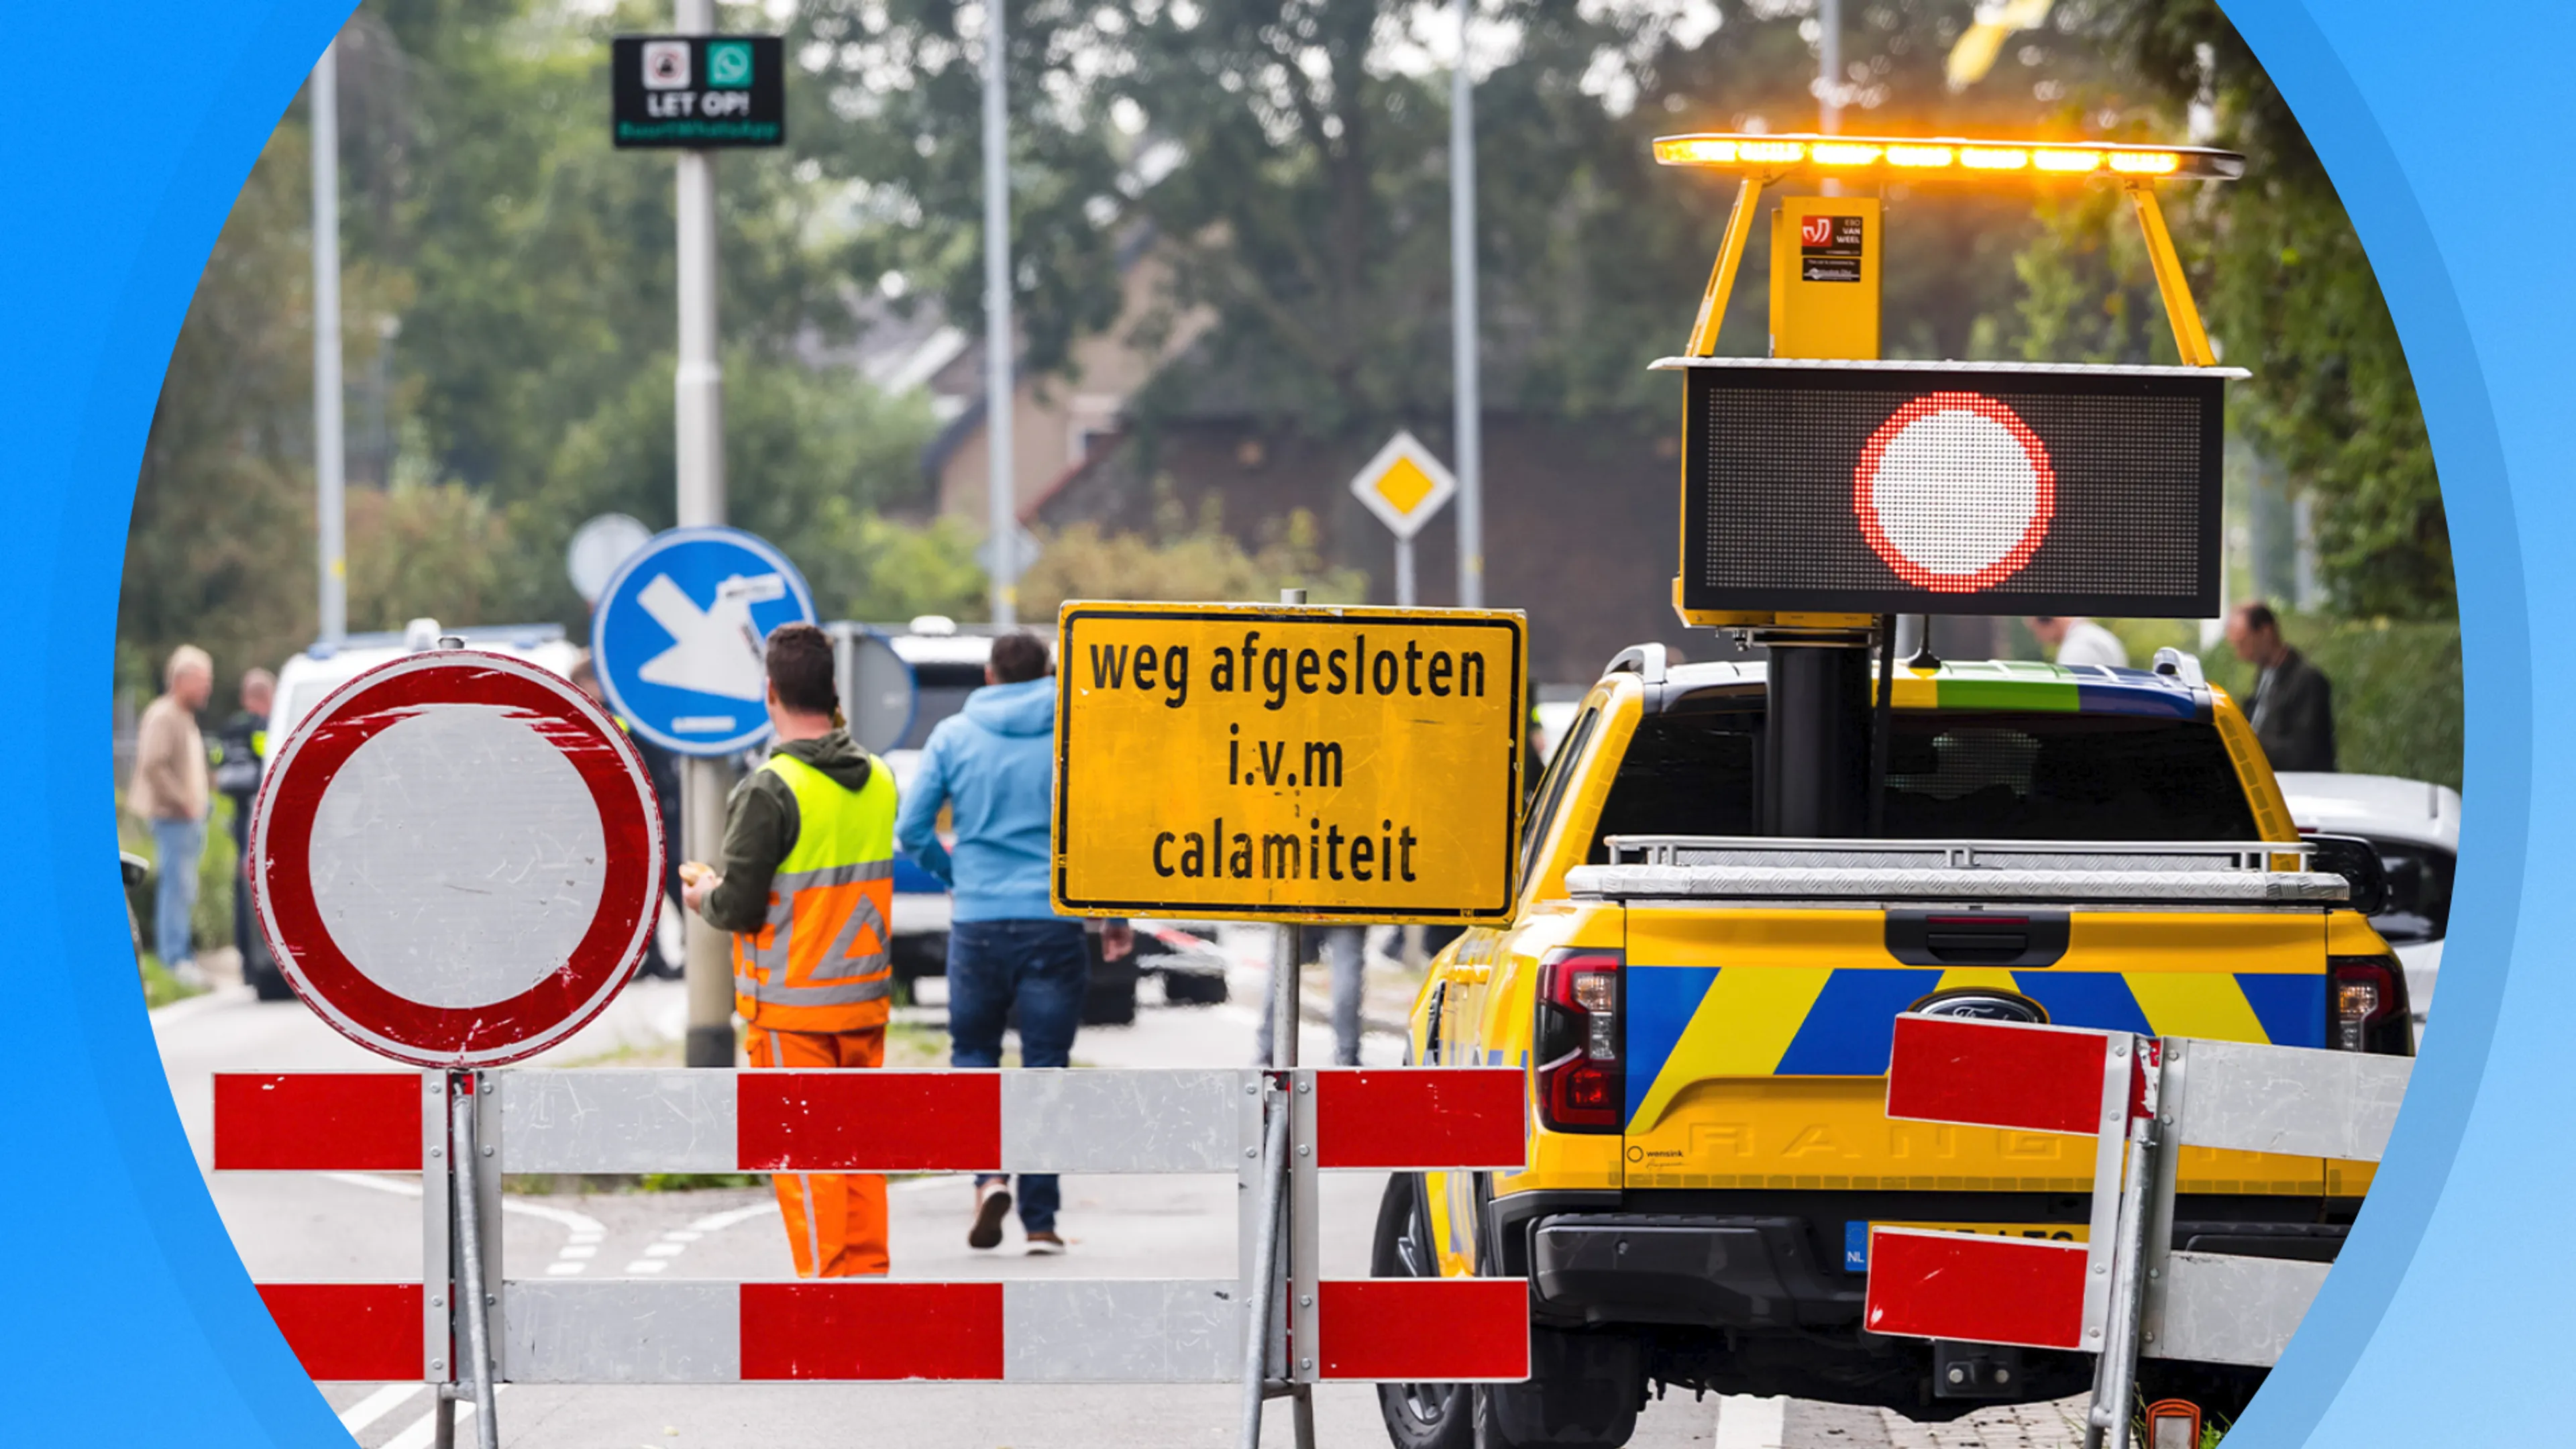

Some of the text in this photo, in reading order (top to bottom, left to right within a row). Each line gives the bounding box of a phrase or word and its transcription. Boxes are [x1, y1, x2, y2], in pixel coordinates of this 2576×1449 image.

[647, 91, 750, 117] LET OP!
[1836, 235, 1860, 244] WEEL
[1089, 631, 1485, 710] weg afgesloten
[1229, 722, 1343, 788] i.v.m
[1152, 816, 1417, 882] calamiteit
[1646, 1149, 1684, 1158] wensink
[1846, 1250, 1865, 1263] NL
